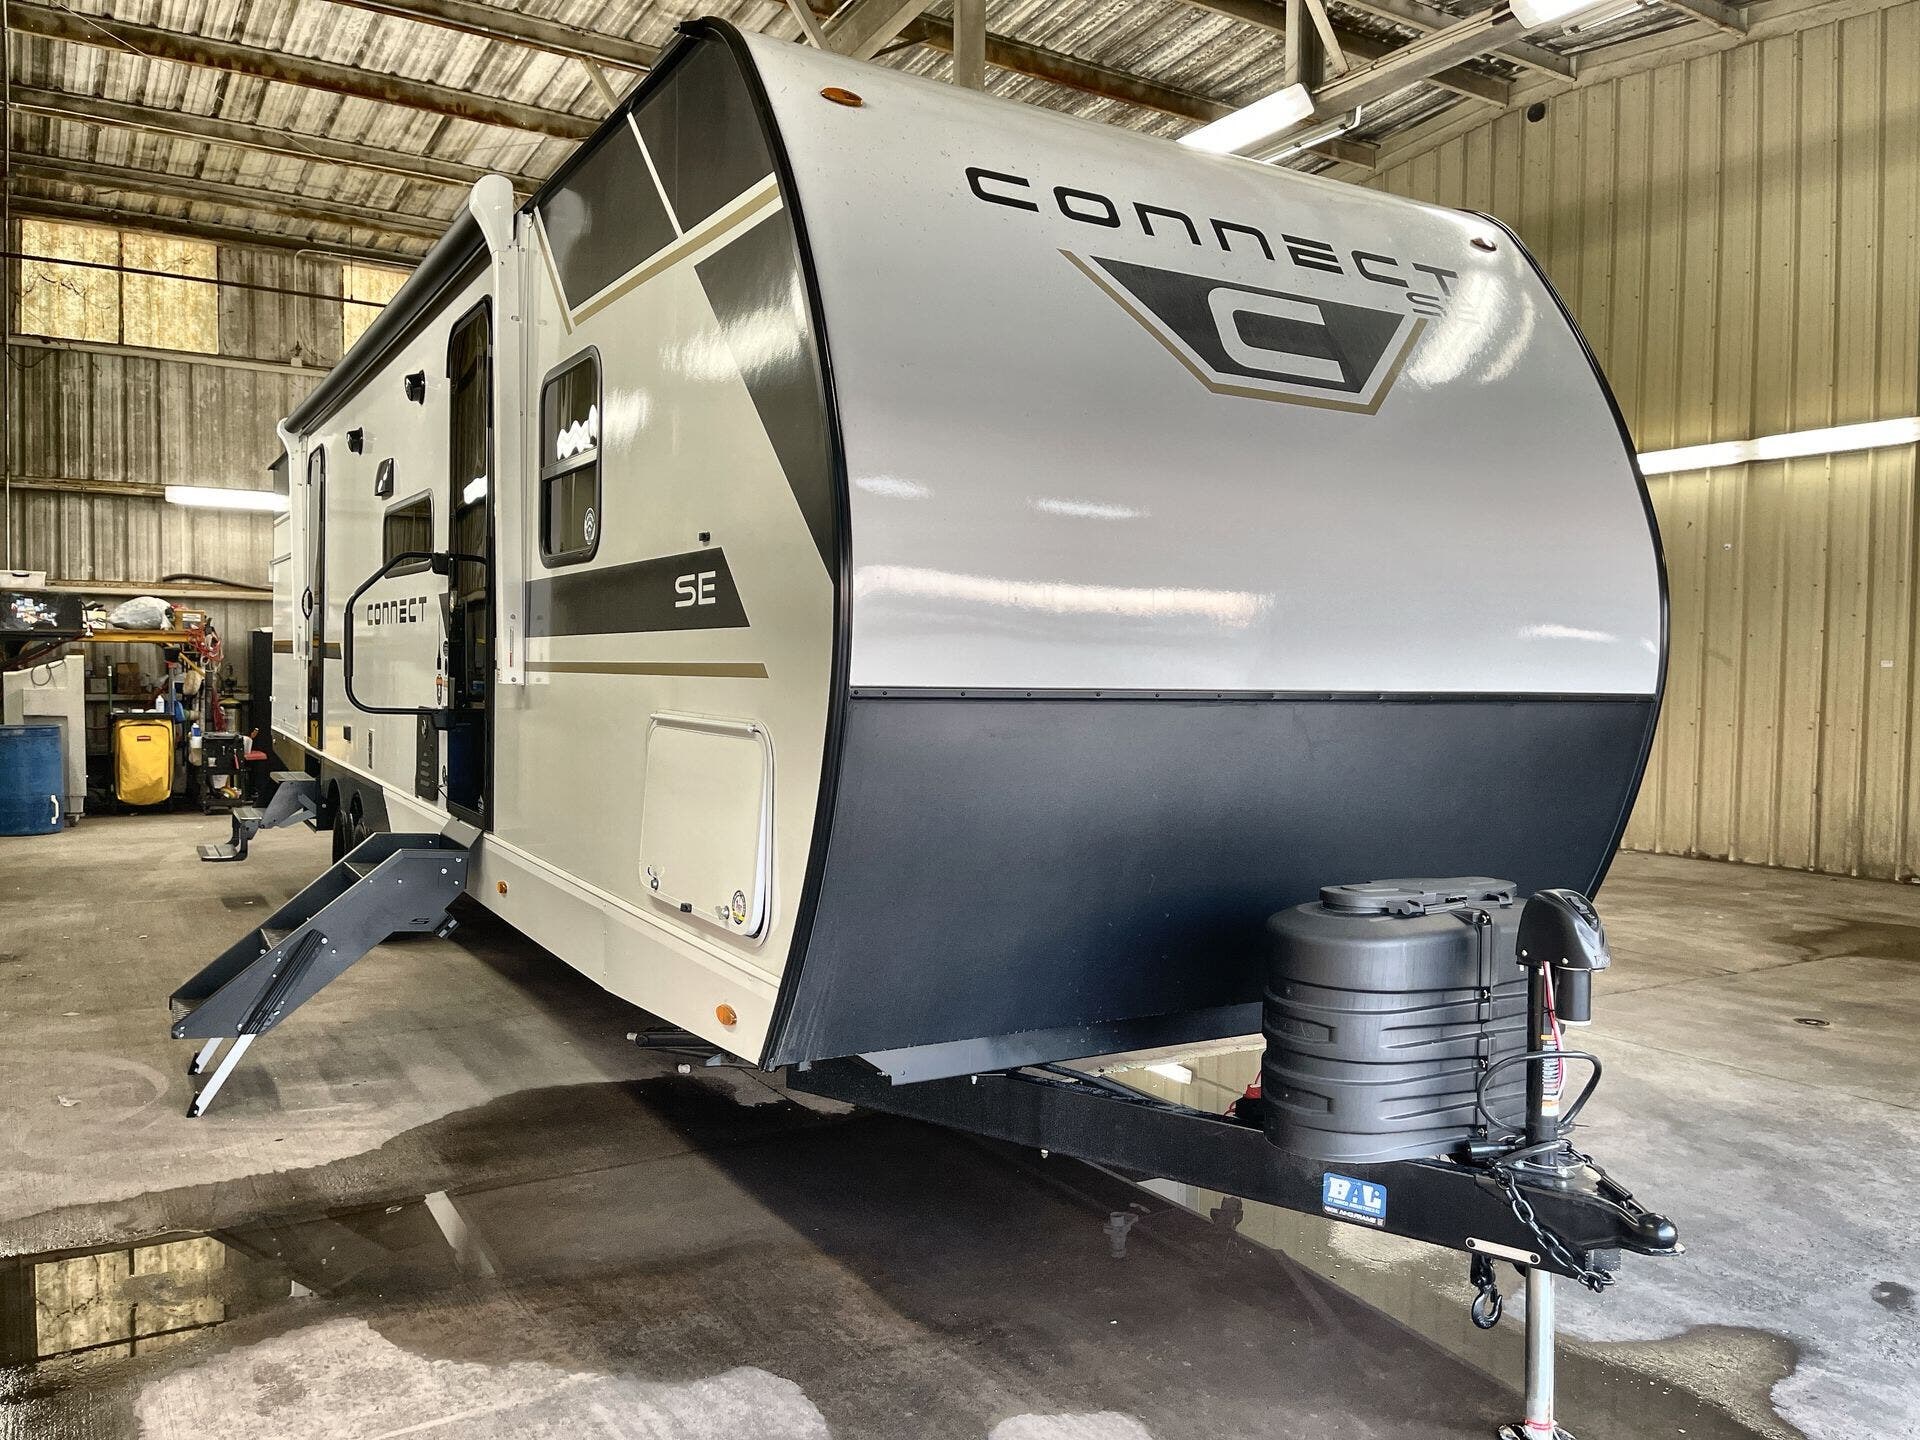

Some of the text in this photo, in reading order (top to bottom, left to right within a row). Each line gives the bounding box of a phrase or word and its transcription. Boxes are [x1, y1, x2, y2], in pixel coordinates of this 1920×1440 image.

[965, 166, 1459, 296] CONNECT
[674, 570, 716, 608] SE
[367, 596, 427, 625] CONNECT
